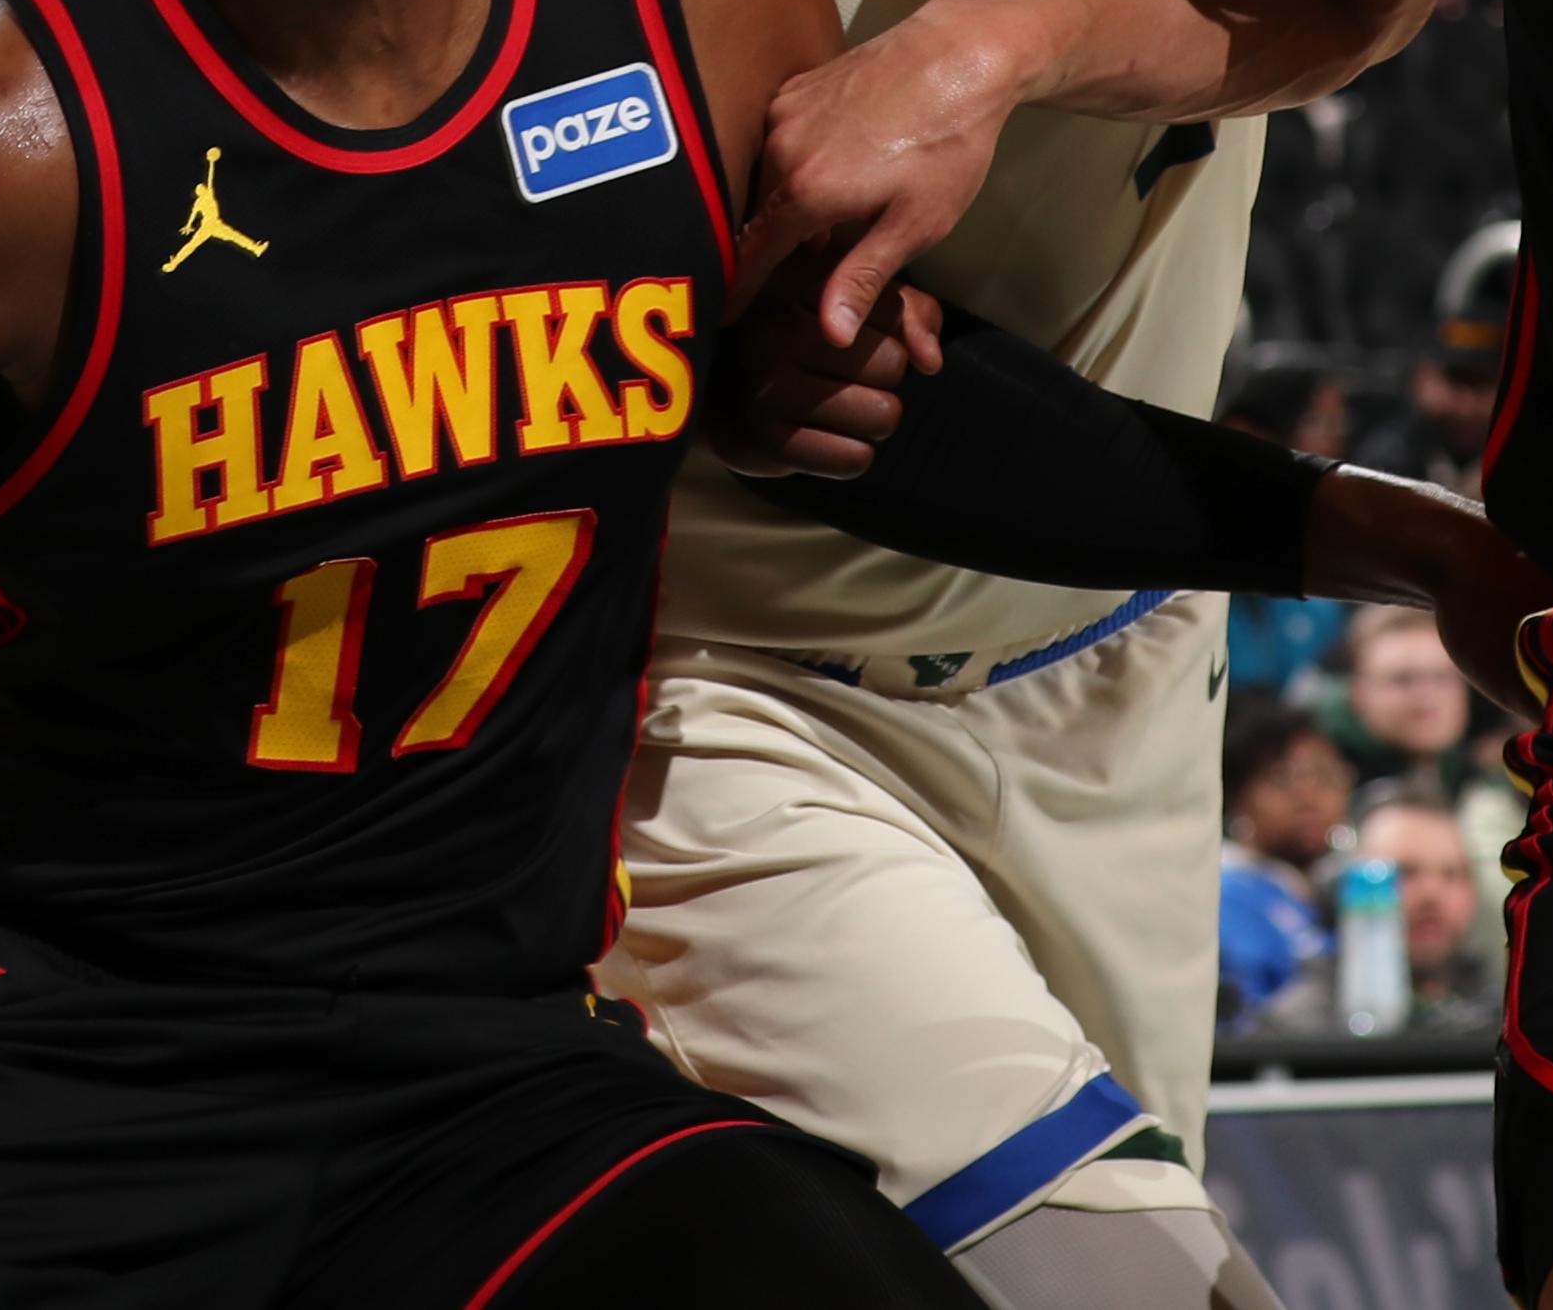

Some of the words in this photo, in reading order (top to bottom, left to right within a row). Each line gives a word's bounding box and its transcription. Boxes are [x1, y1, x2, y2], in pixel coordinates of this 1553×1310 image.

[519, 96, 652, 174] paze
[142, 276, 694, 547] HAWKS
[247, 508, 598, 773] 17
